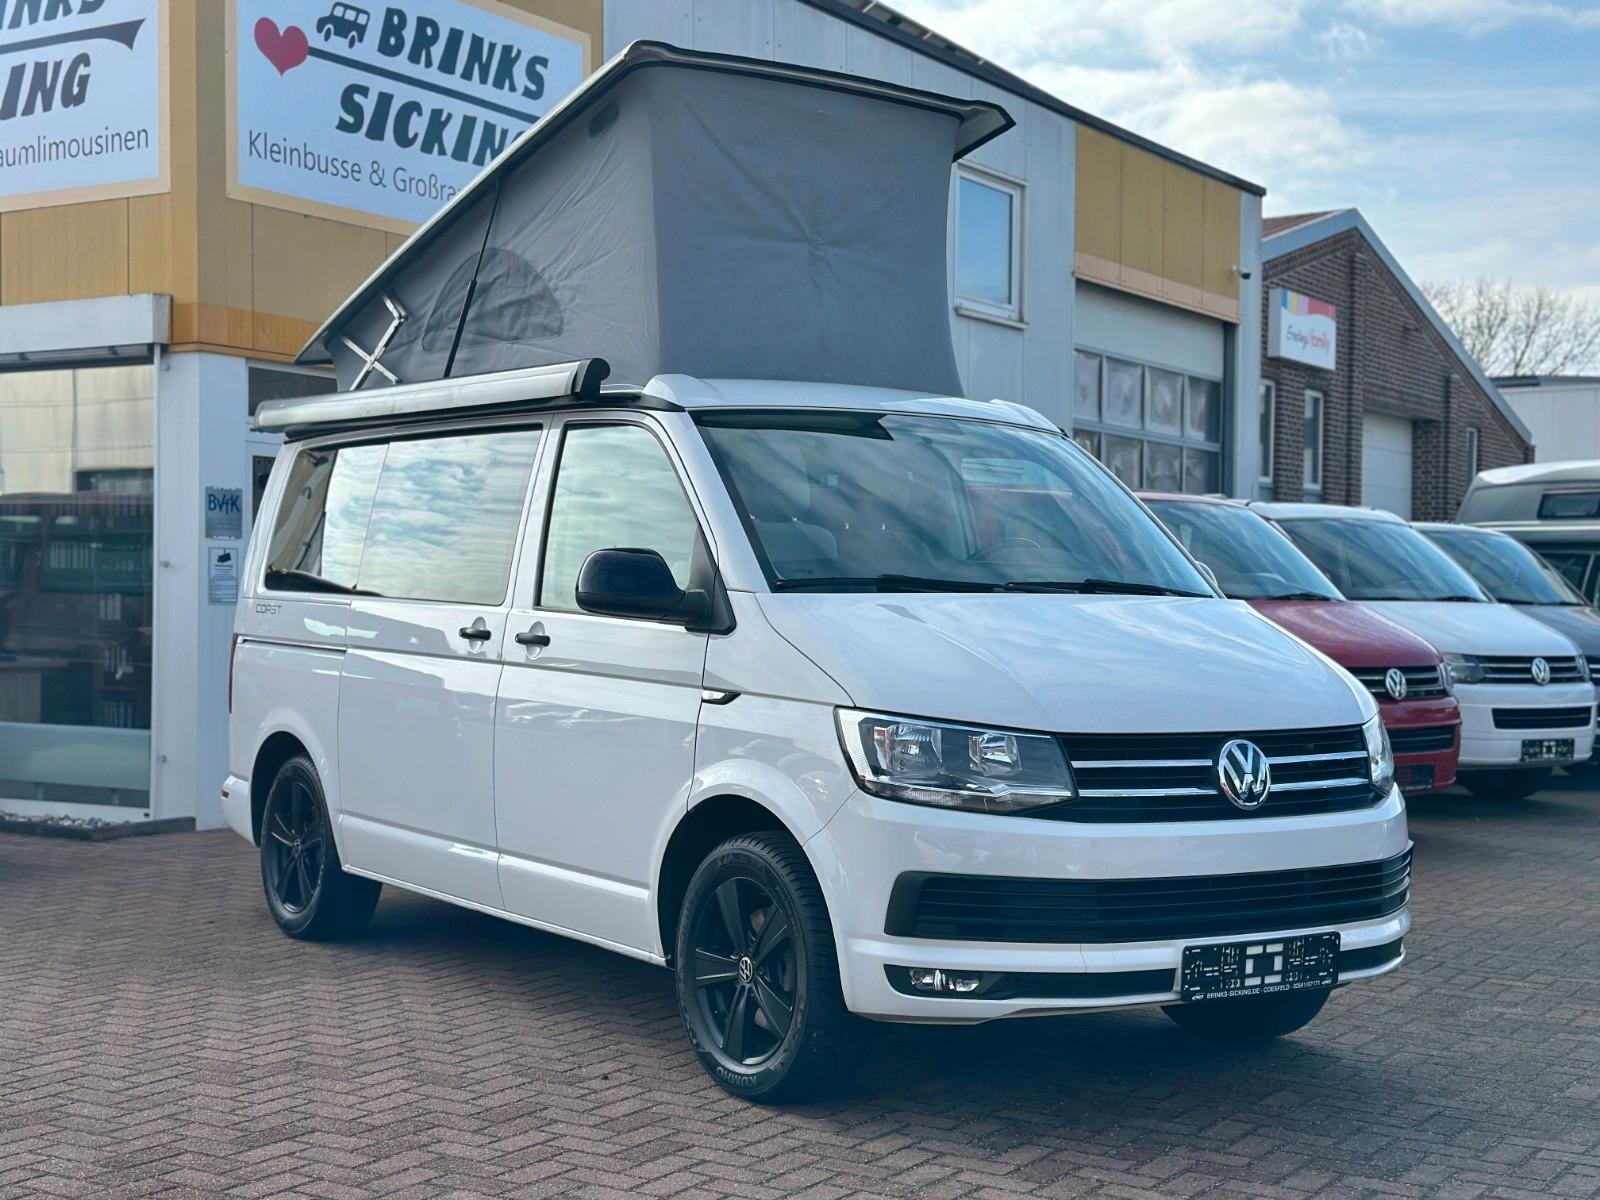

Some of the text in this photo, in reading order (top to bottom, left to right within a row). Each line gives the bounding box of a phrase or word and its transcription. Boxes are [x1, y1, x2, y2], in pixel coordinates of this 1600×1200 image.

[0, 52, 91, 121] ING
[376, 6, 550, 101] BRINKS
[335, 83, 527, 168] SICKIN
[248, 130, 464, 202] Kleinbusse & Großra
[208, 493, 241, 515] BVfK
[1220, 740, 1270, 808] VW
